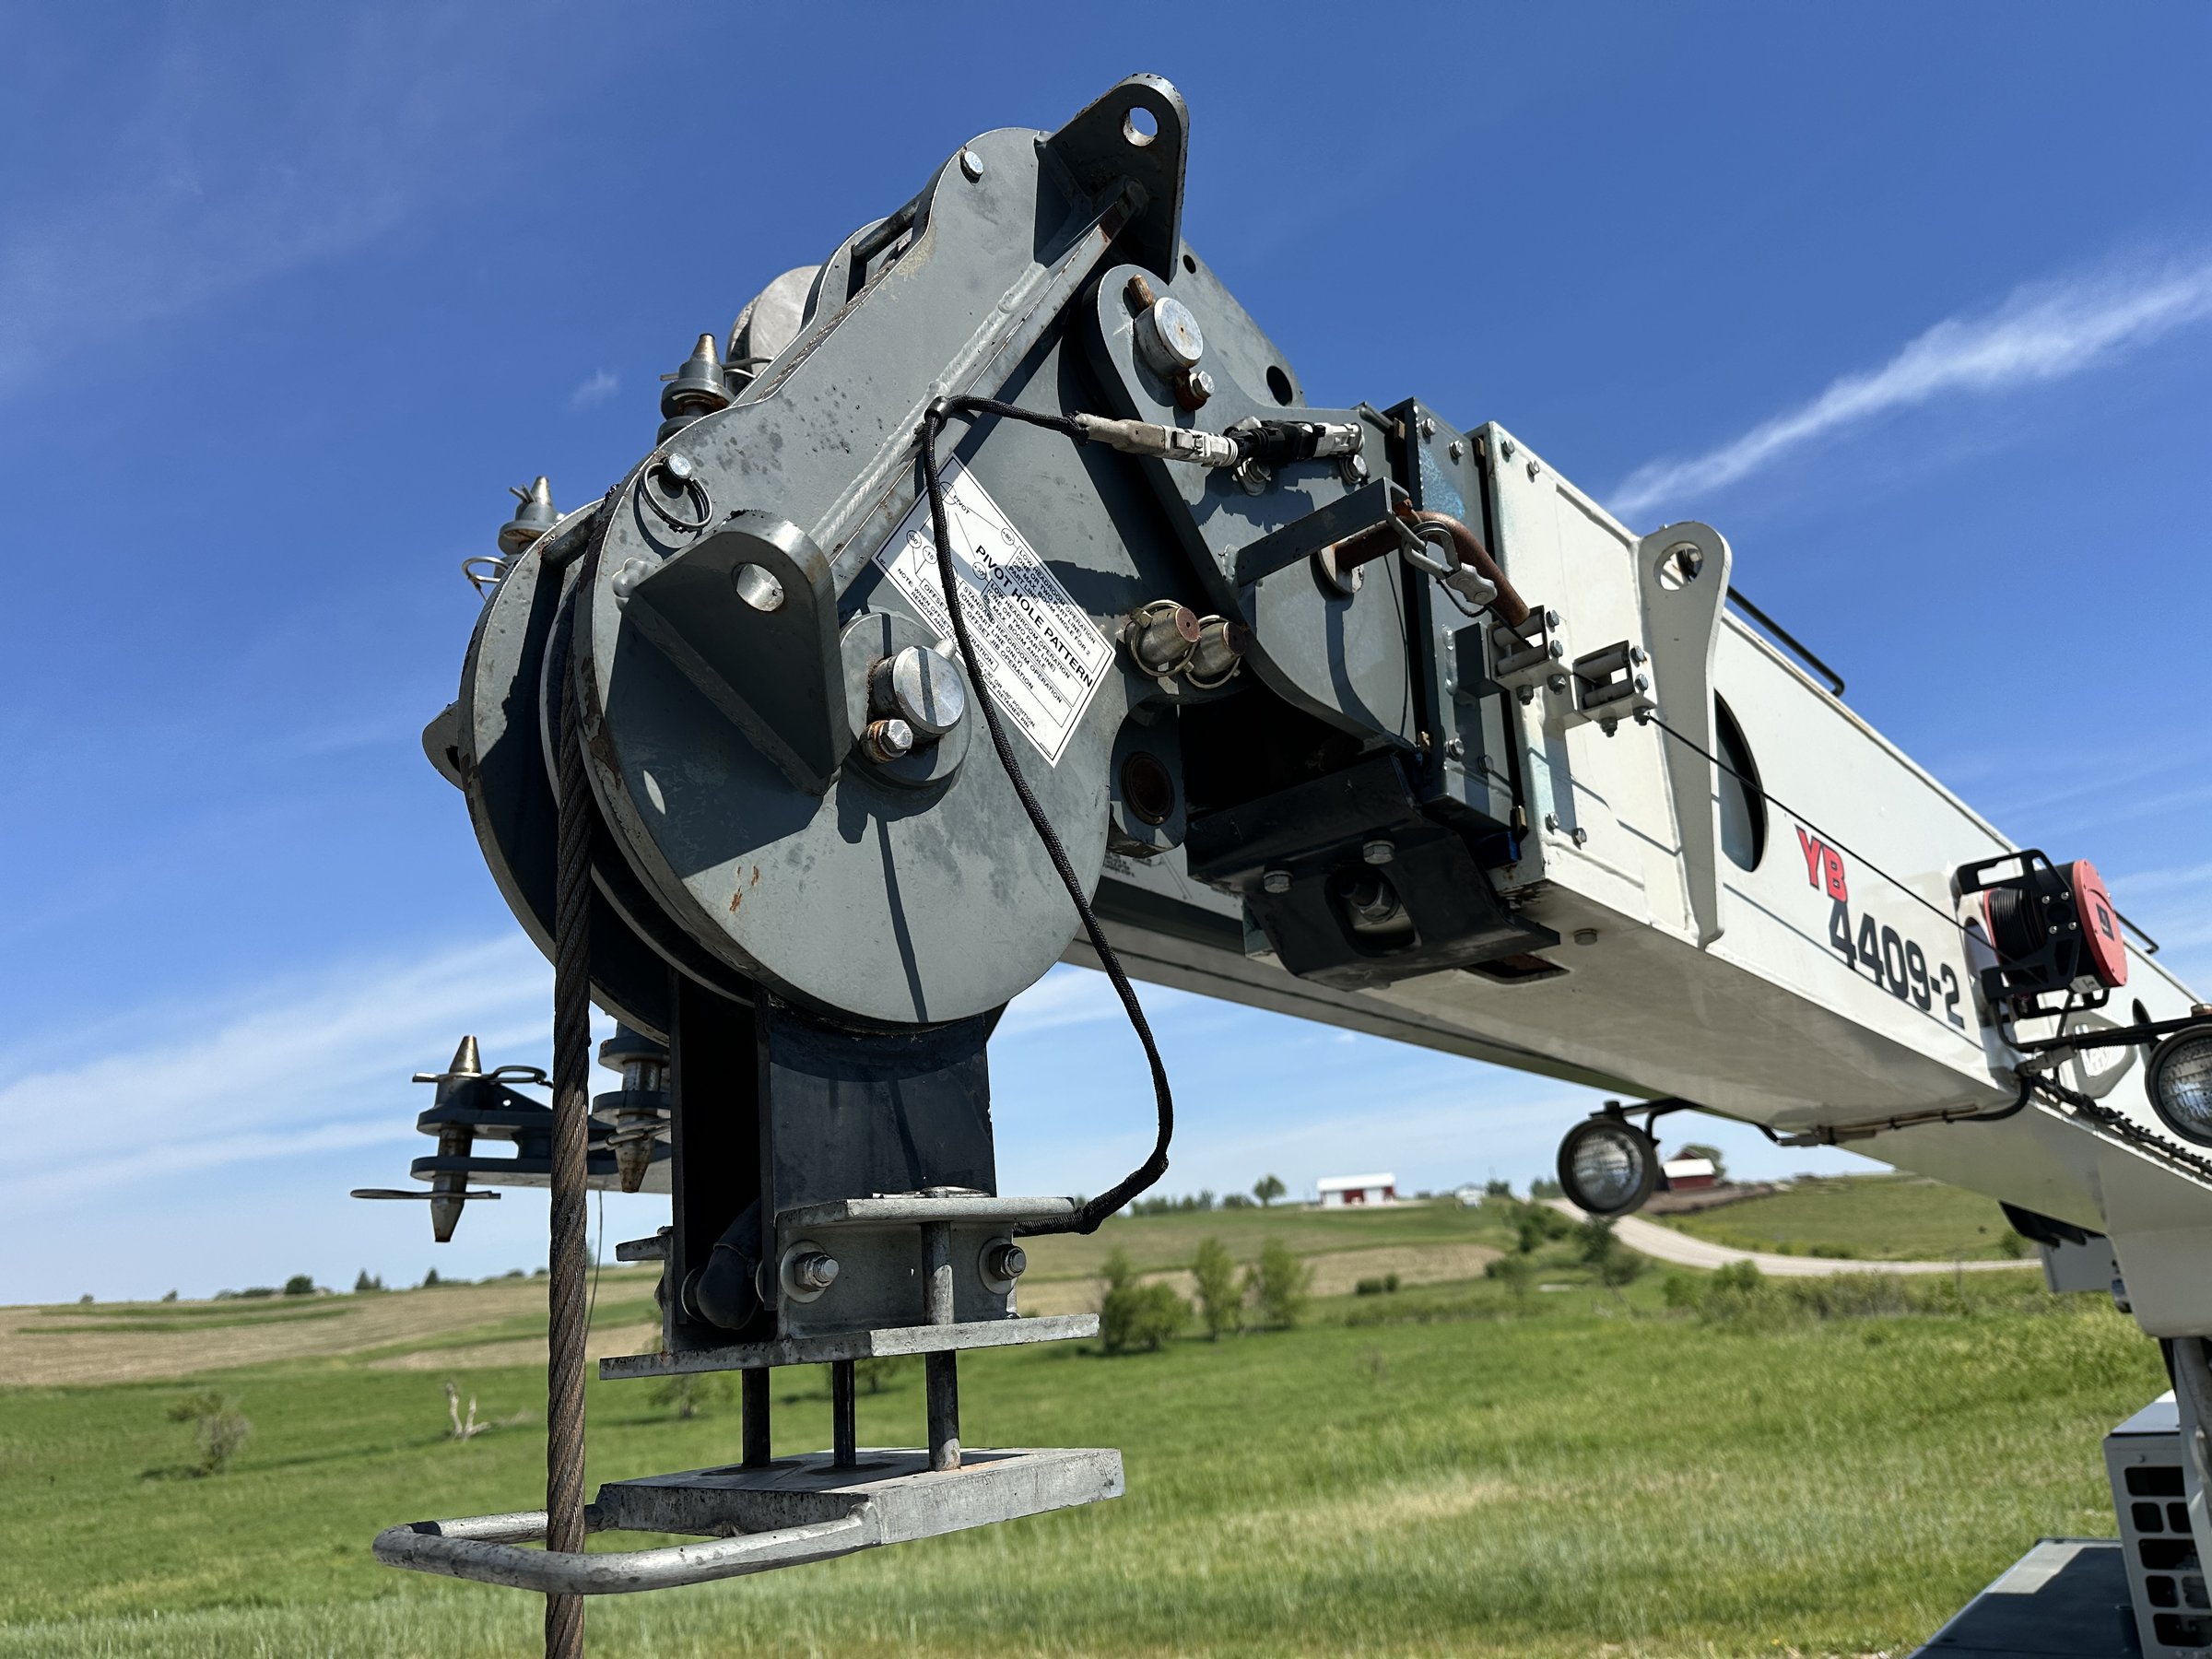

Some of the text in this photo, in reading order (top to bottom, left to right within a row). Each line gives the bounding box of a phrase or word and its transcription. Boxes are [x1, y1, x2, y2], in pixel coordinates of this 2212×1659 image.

[952, 494, 970, 515] PIVOT
[911, 590, 946, 631] REMOVE AND
[913, 586, 930, 606] WHEN
[923, 582, 947, 612] OFFSET
[1008, 565, 1039, 604] PART LINE)
[1015, 555, 1082, 637] (ONE OR TWO PART LINE)
[1018, 549, 1095, 643] LOW HEADROOM OPERATION
[959, 591, 1023, 668] (ONE PART LINE ONLY)
[962, 585, 995, 625] STANDARD
[994, 623, 1030, 665] HEADROOM
[1029, 664, 1062, 704] OPERATION
[975, 544, 1093, 688] PIVOT HOLE PATTERN
[986, 588, 1056, 673] (ONE OR TWO PART LINE)
[990, 582, 1070, 679] LOW HEADROOM OPERATION
[1007, 623, 1027, 647] BOOM
[1026, 644, 1046, 670] ANGLE
[1037, 590, 1055, 614] BOOM
[1054, 612, 1074, 636] ANGLE
[1074, 634, 1086, 651] FOR
[975, 657, 984, 668] TO
[994, 677, 1003, 689] OR
[989, 637, 1000, 651] JIB
[999, 649, 1033, 689] OPERATION
[997, 689, 1020, 718] RETAINER
[1794, 824, 1848, 902] YB
[1829, 900, 1965, 1030] 4409-2
